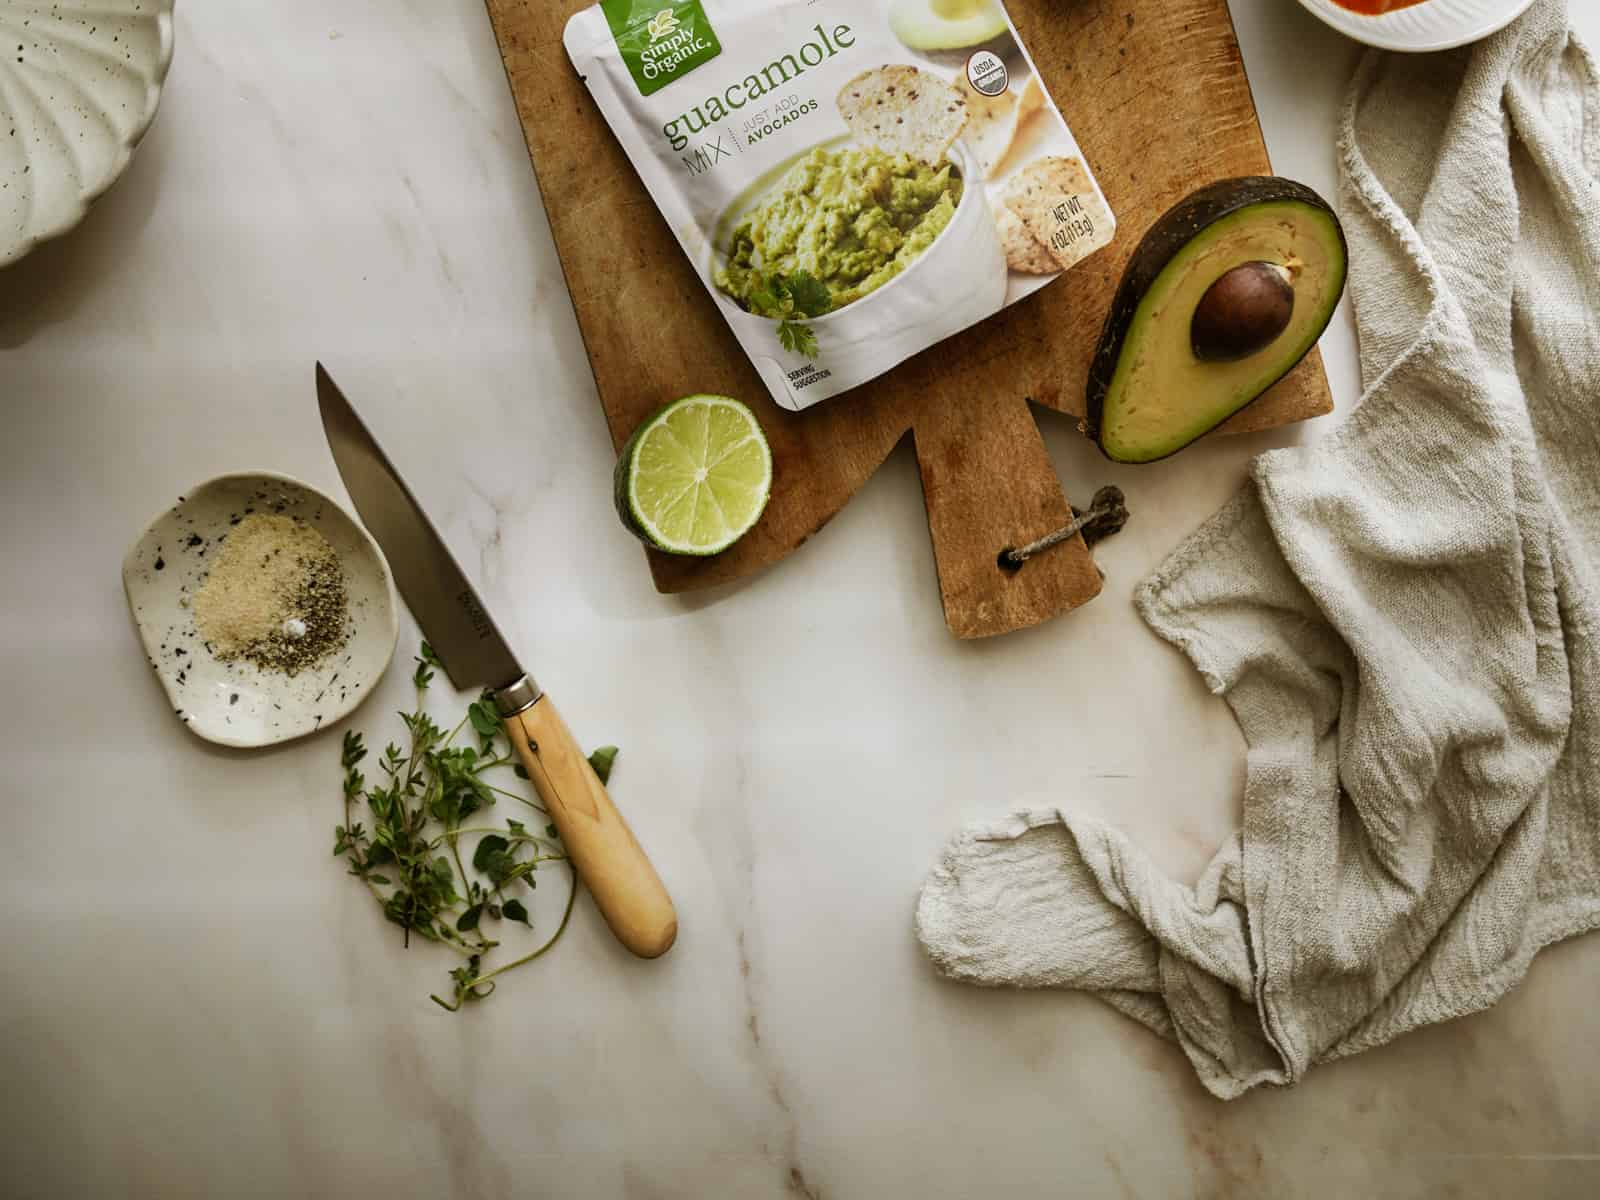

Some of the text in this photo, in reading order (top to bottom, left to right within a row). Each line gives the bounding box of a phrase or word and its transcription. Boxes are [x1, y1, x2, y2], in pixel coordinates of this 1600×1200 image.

[640, 26, 695, 63] Simply
[973, 57, 996, 76] USDA
[663, 23, 856, 152] guacamole
[742, 93, 800, 134] JUST ADD
[747, 98, 819, 145] AVOCADOS
[682, 135, 732, 177] MIX
[1052, 202, 1071, 225] NET
